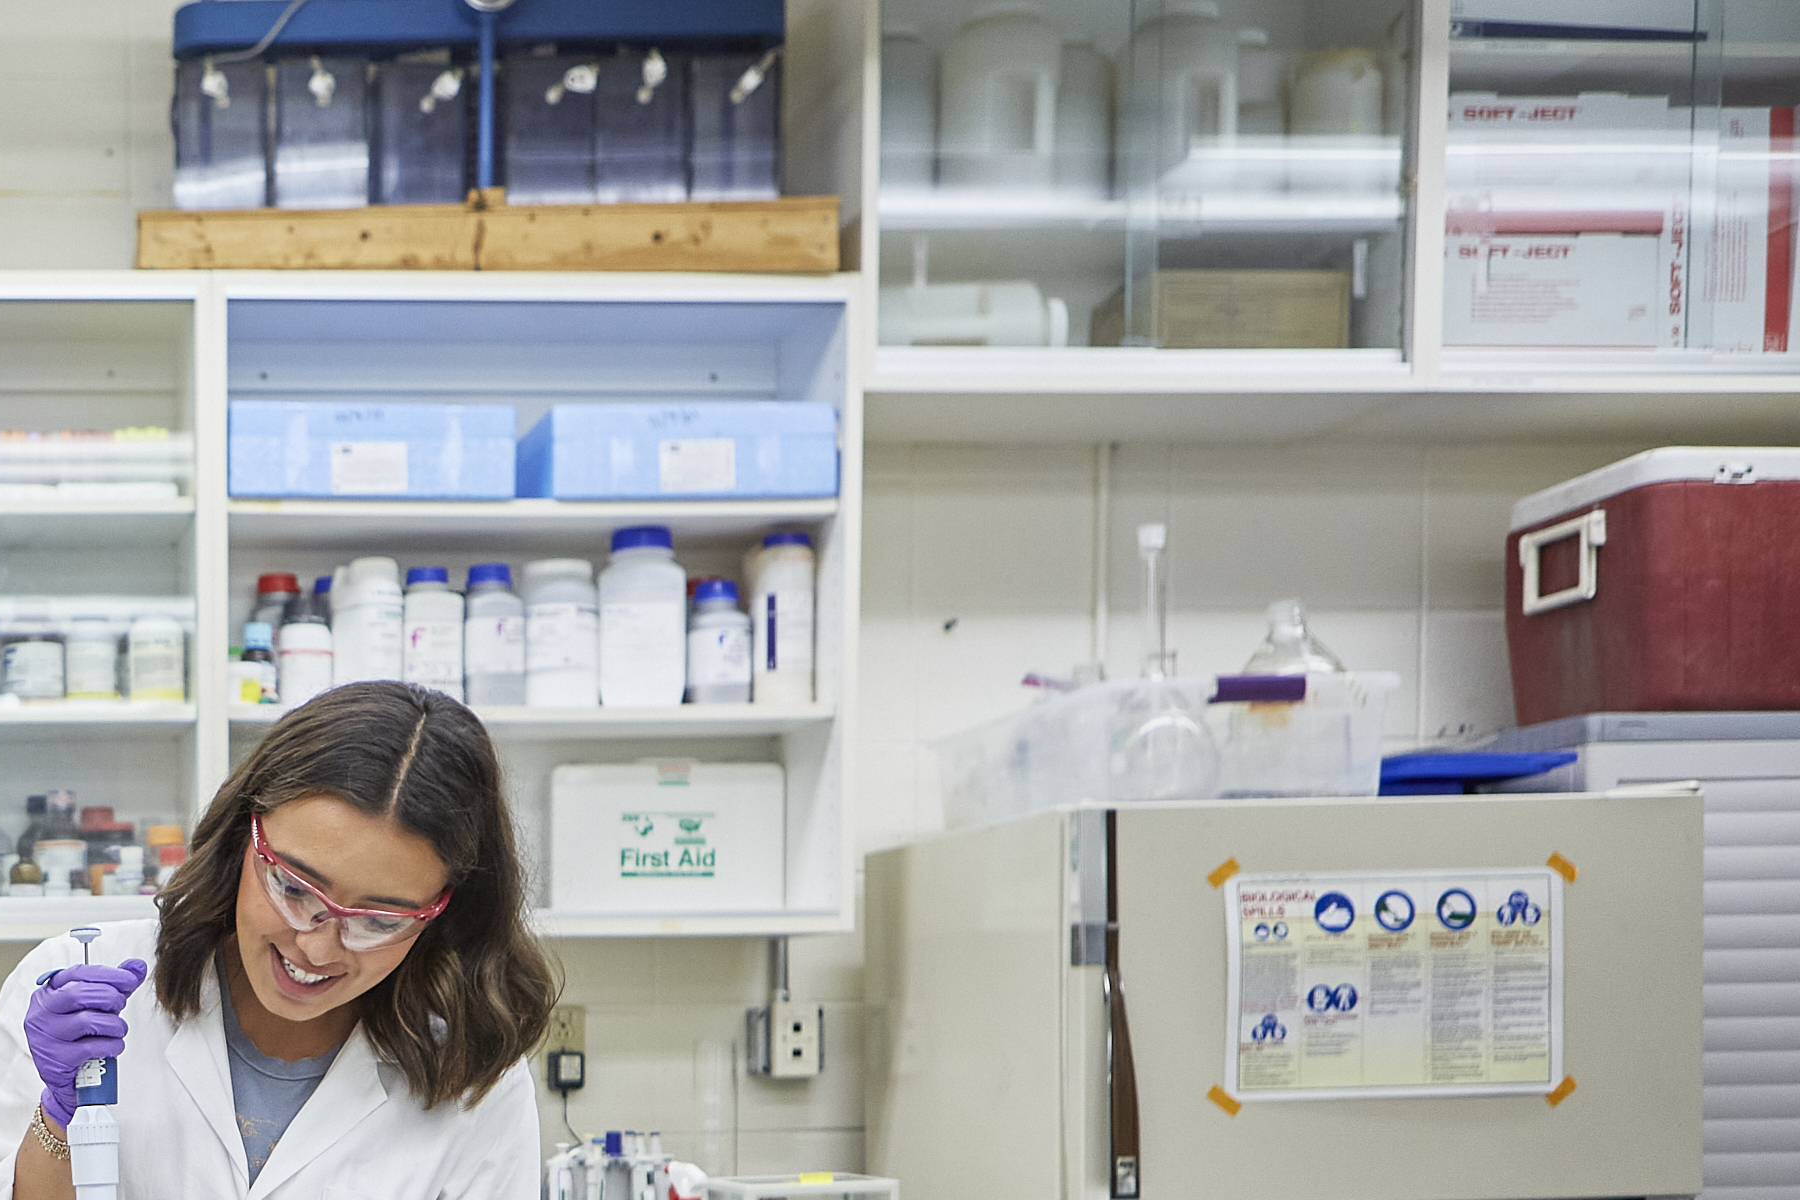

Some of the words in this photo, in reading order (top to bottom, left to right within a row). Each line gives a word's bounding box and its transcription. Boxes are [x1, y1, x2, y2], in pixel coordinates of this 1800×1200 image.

[1668, 193, 1684, 316] SOFT-JEC
[621, 847, 670, 867] First
[679, 847, 715, 867] Aid
[1241, 890, 1317, 904] BIOLOGICAL
[1241, 904, 1286, 916] SPILLS
